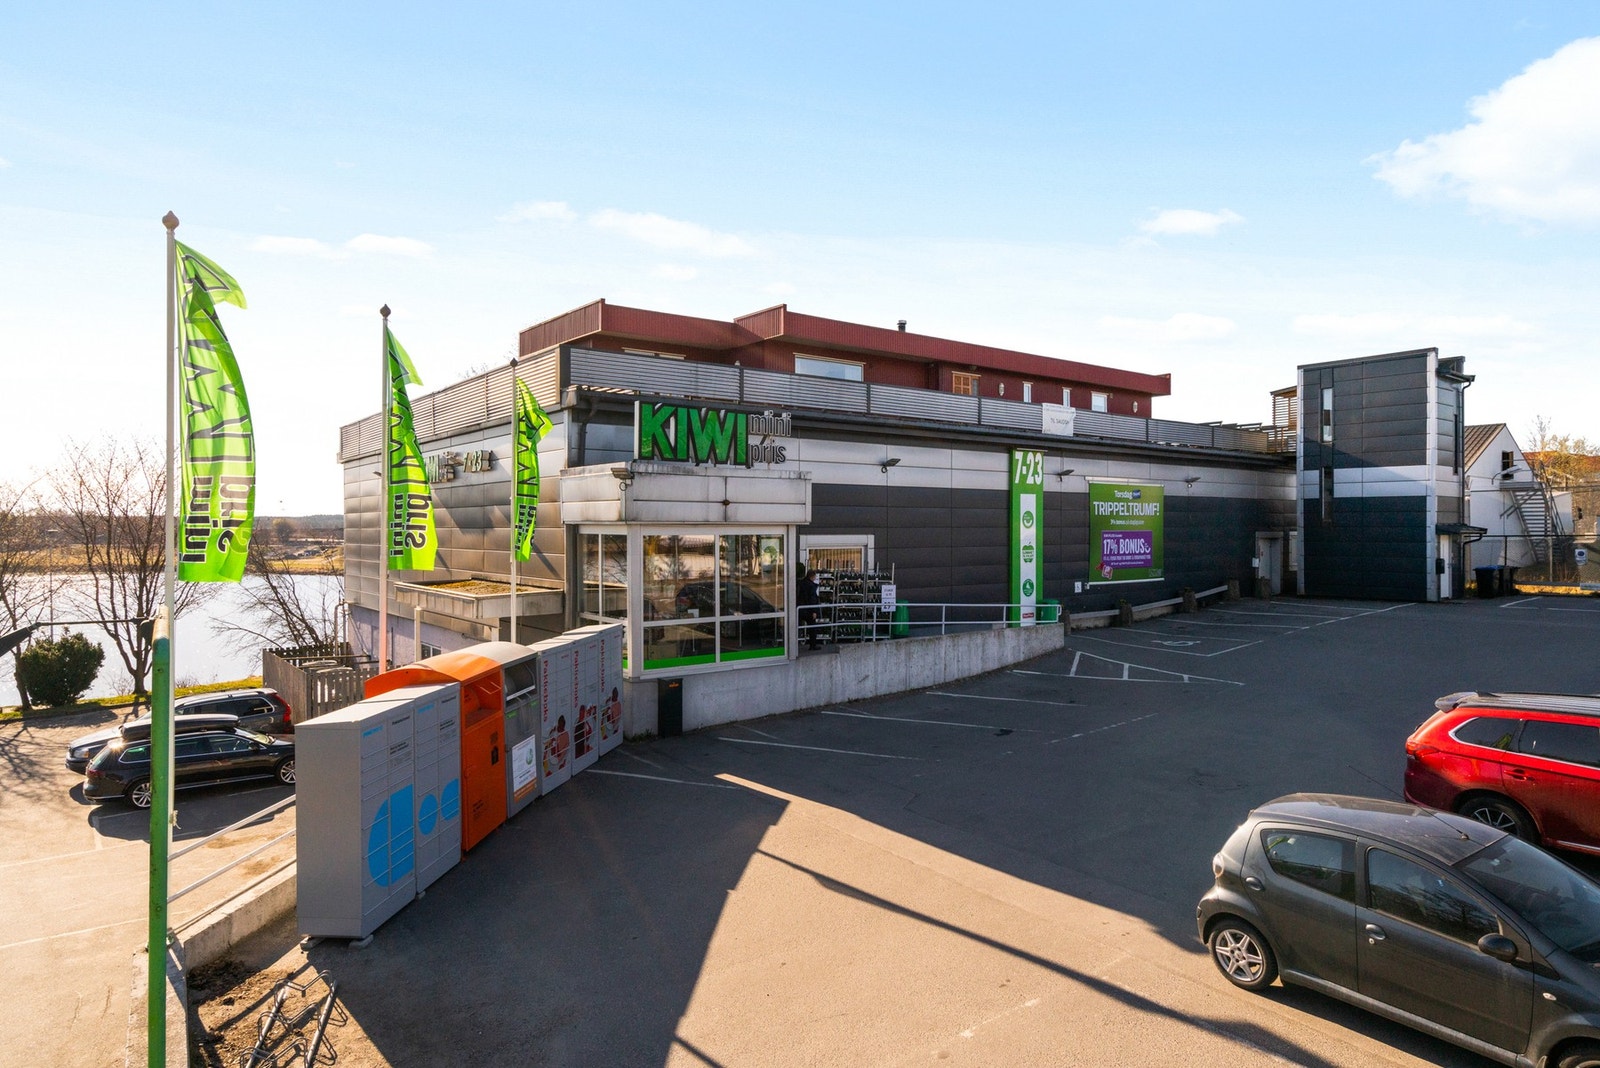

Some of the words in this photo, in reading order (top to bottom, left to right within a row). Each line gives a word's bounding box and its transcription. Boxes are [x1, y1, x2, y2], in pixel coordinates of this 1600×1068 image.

[640, 402, 749, 465] KIWI
[750, 410, 792, 437] mini
[750, 438, 787, 468] pris
[1014, 452, 1043, 486] 7-23
[1093, 501, 1160, 516] TRIPPELTRUMF!
[1103, 539, 1118, 555] 17%
[1119, 538, 1145, 554] BONUS
